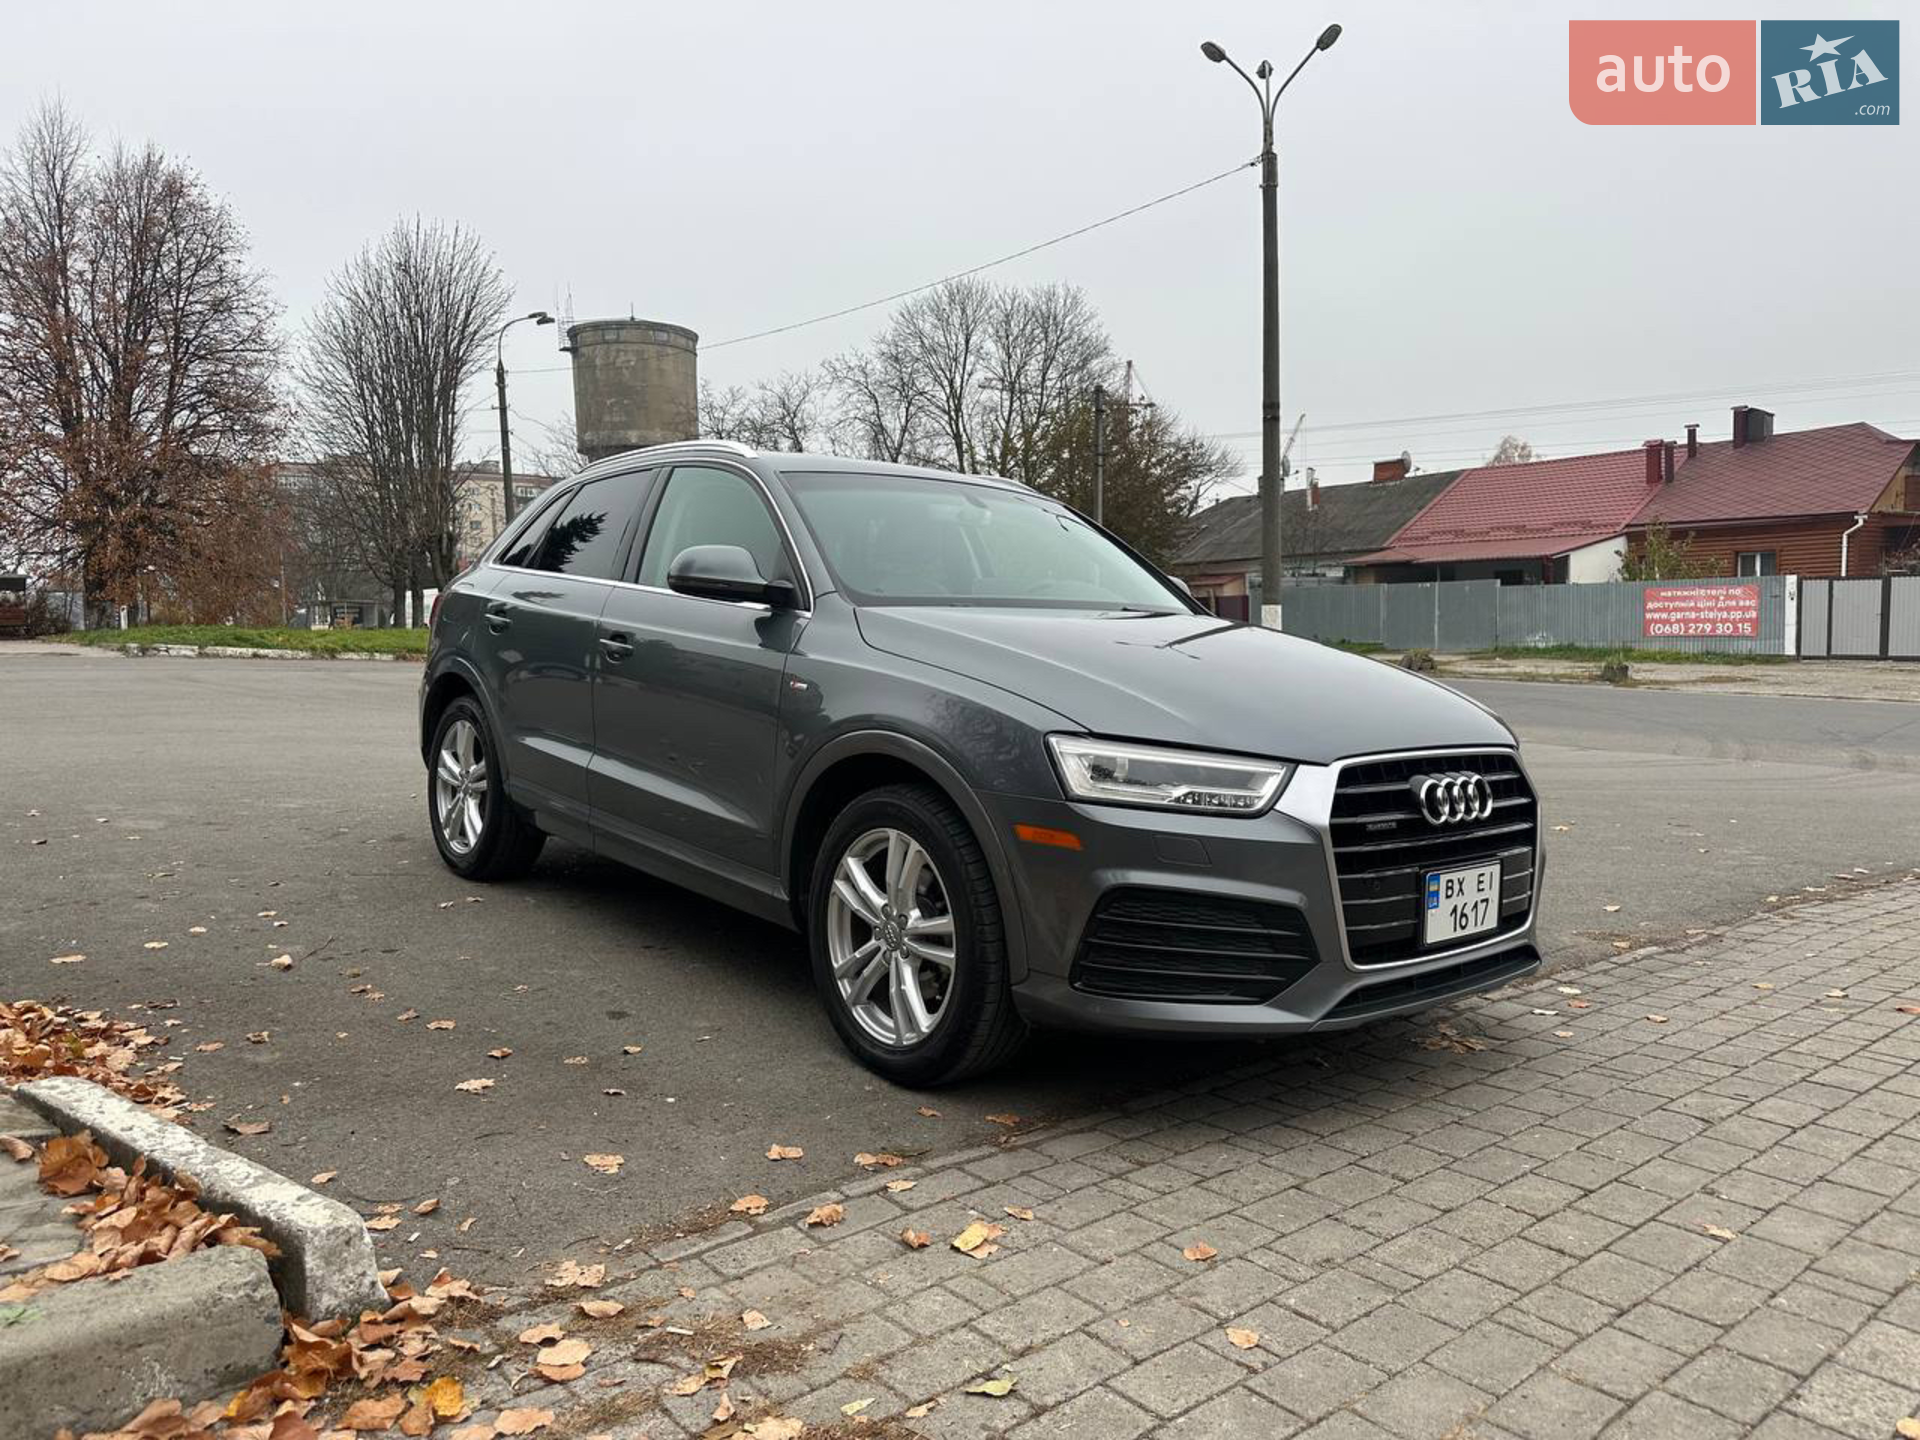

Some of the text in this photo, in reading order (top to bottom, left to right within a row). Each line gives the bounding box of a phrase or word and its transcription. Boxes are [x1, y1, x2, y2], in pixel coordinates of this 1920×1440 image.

[1728, 588, 1741, 597] по
[1650, 622, 1752, 635] (068) 279 30 15
[1445, 871, 1493, 899] BX EI
[1449, 898, 1489, 933] 1617
